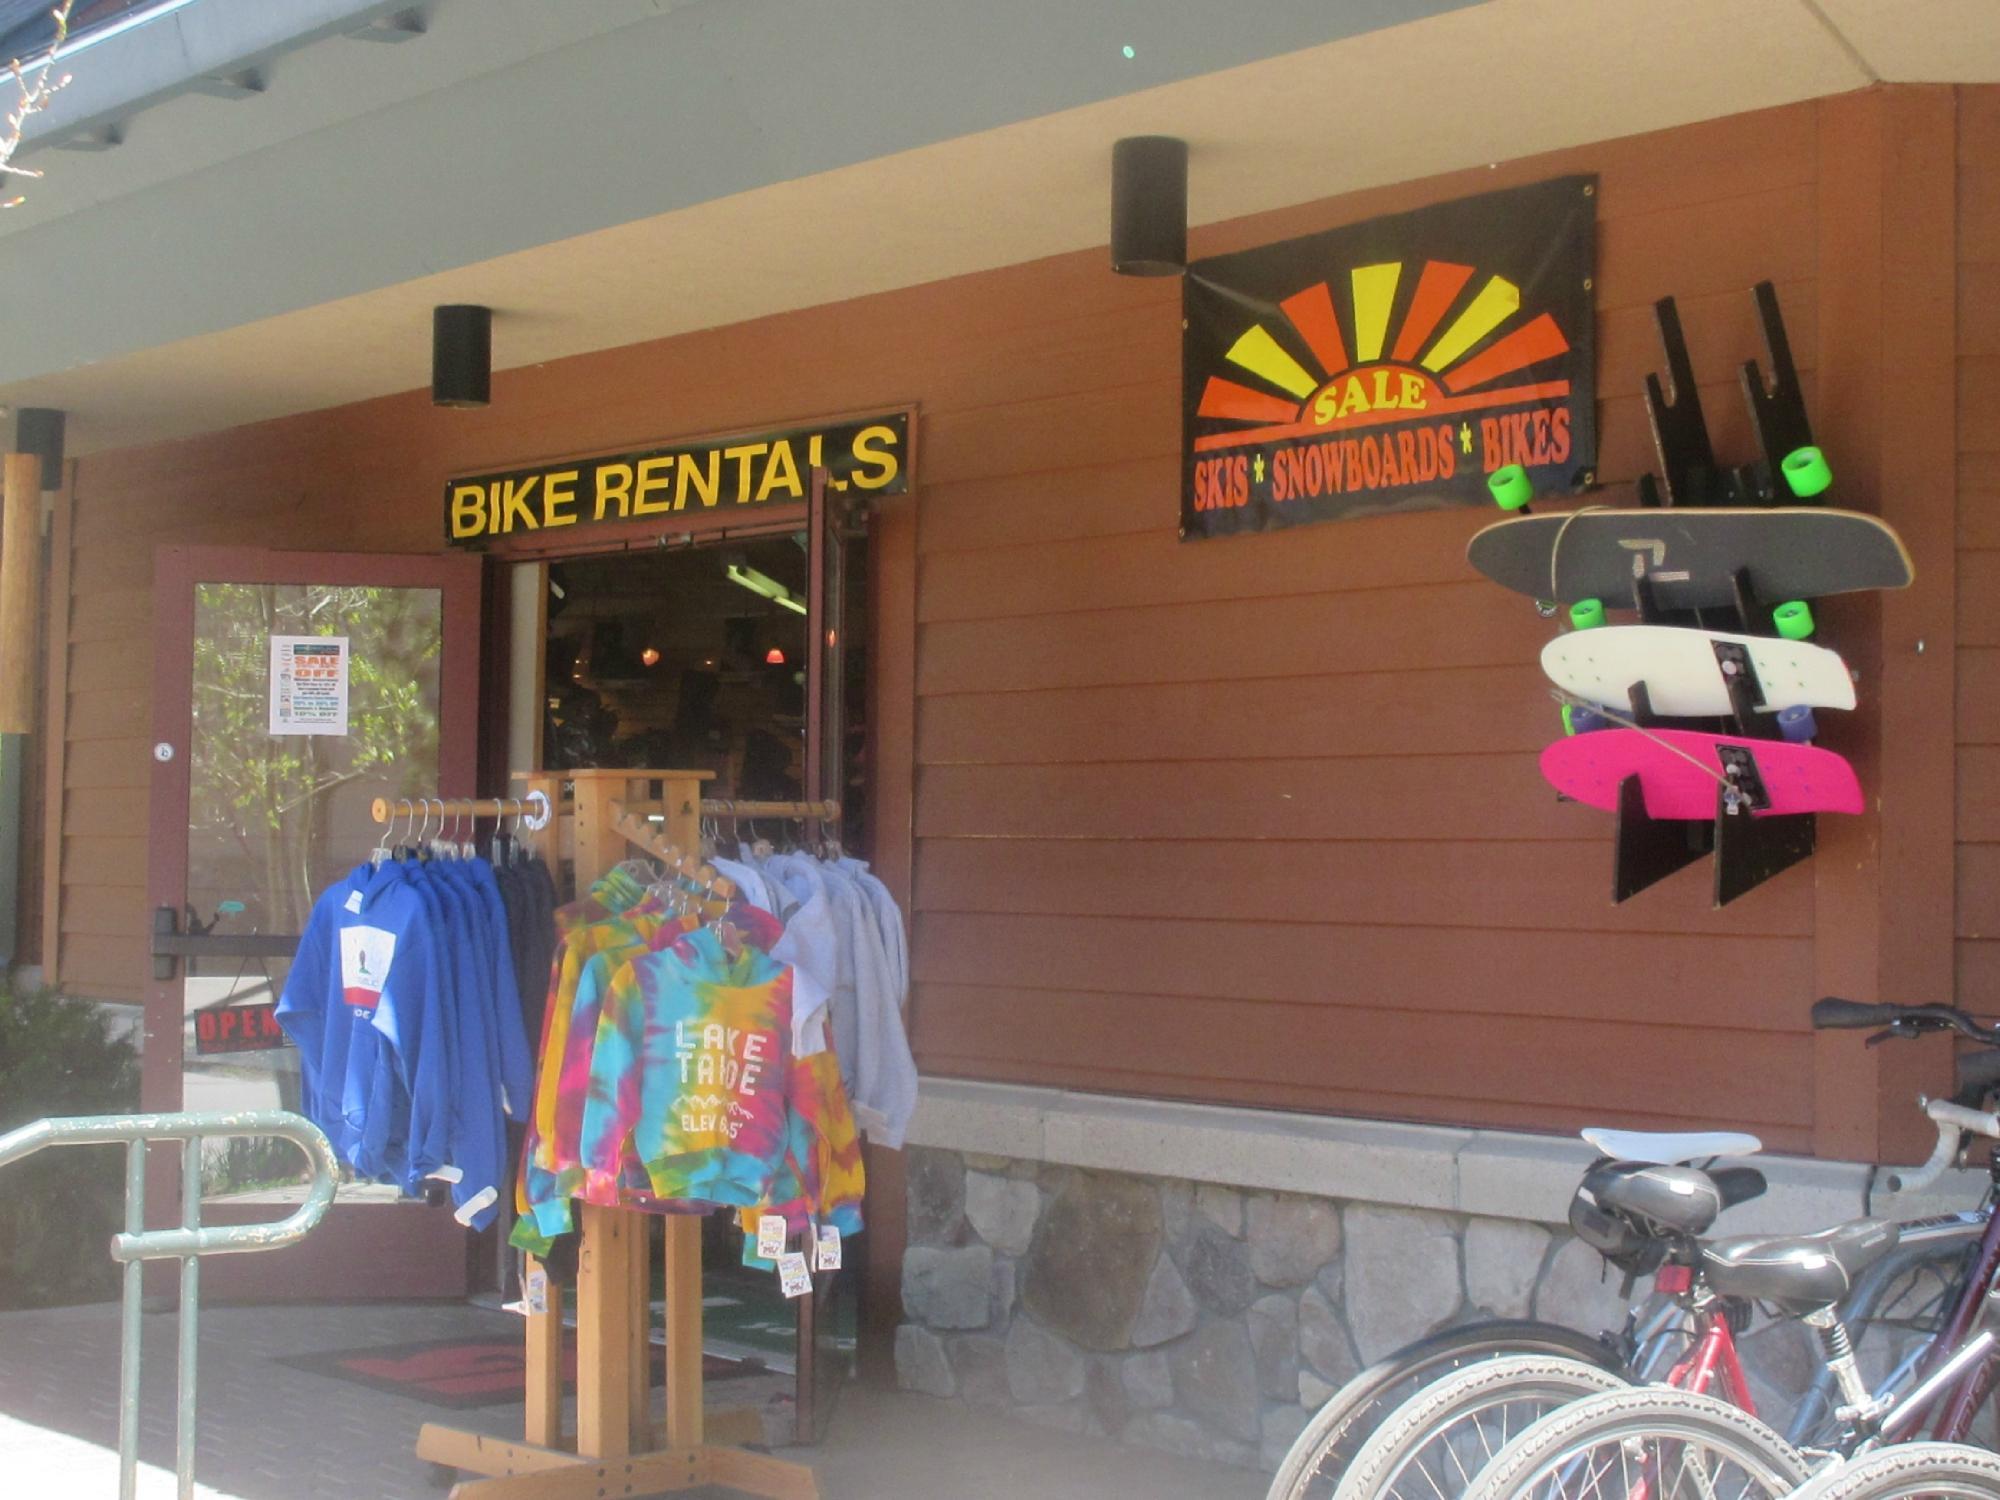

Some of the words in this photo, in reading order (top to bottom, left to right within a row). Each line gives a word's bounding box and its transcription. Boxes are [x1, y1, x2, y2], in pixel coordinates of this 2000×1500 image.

[1314, 369, 1428, 426] SALE
[1194, 455, 1249, 512] SKIS
[1272, 423, 1456, 502] SNOWBOARDS
[1481, 407, 1571, 473] BIKES
[451, 470, 579, 539] BIKE
[198, 1007, 282, 1041] OPEN
[675, 1020, 768, 1063] LAKE
[681, 1114, 717, 1132] ELEV
